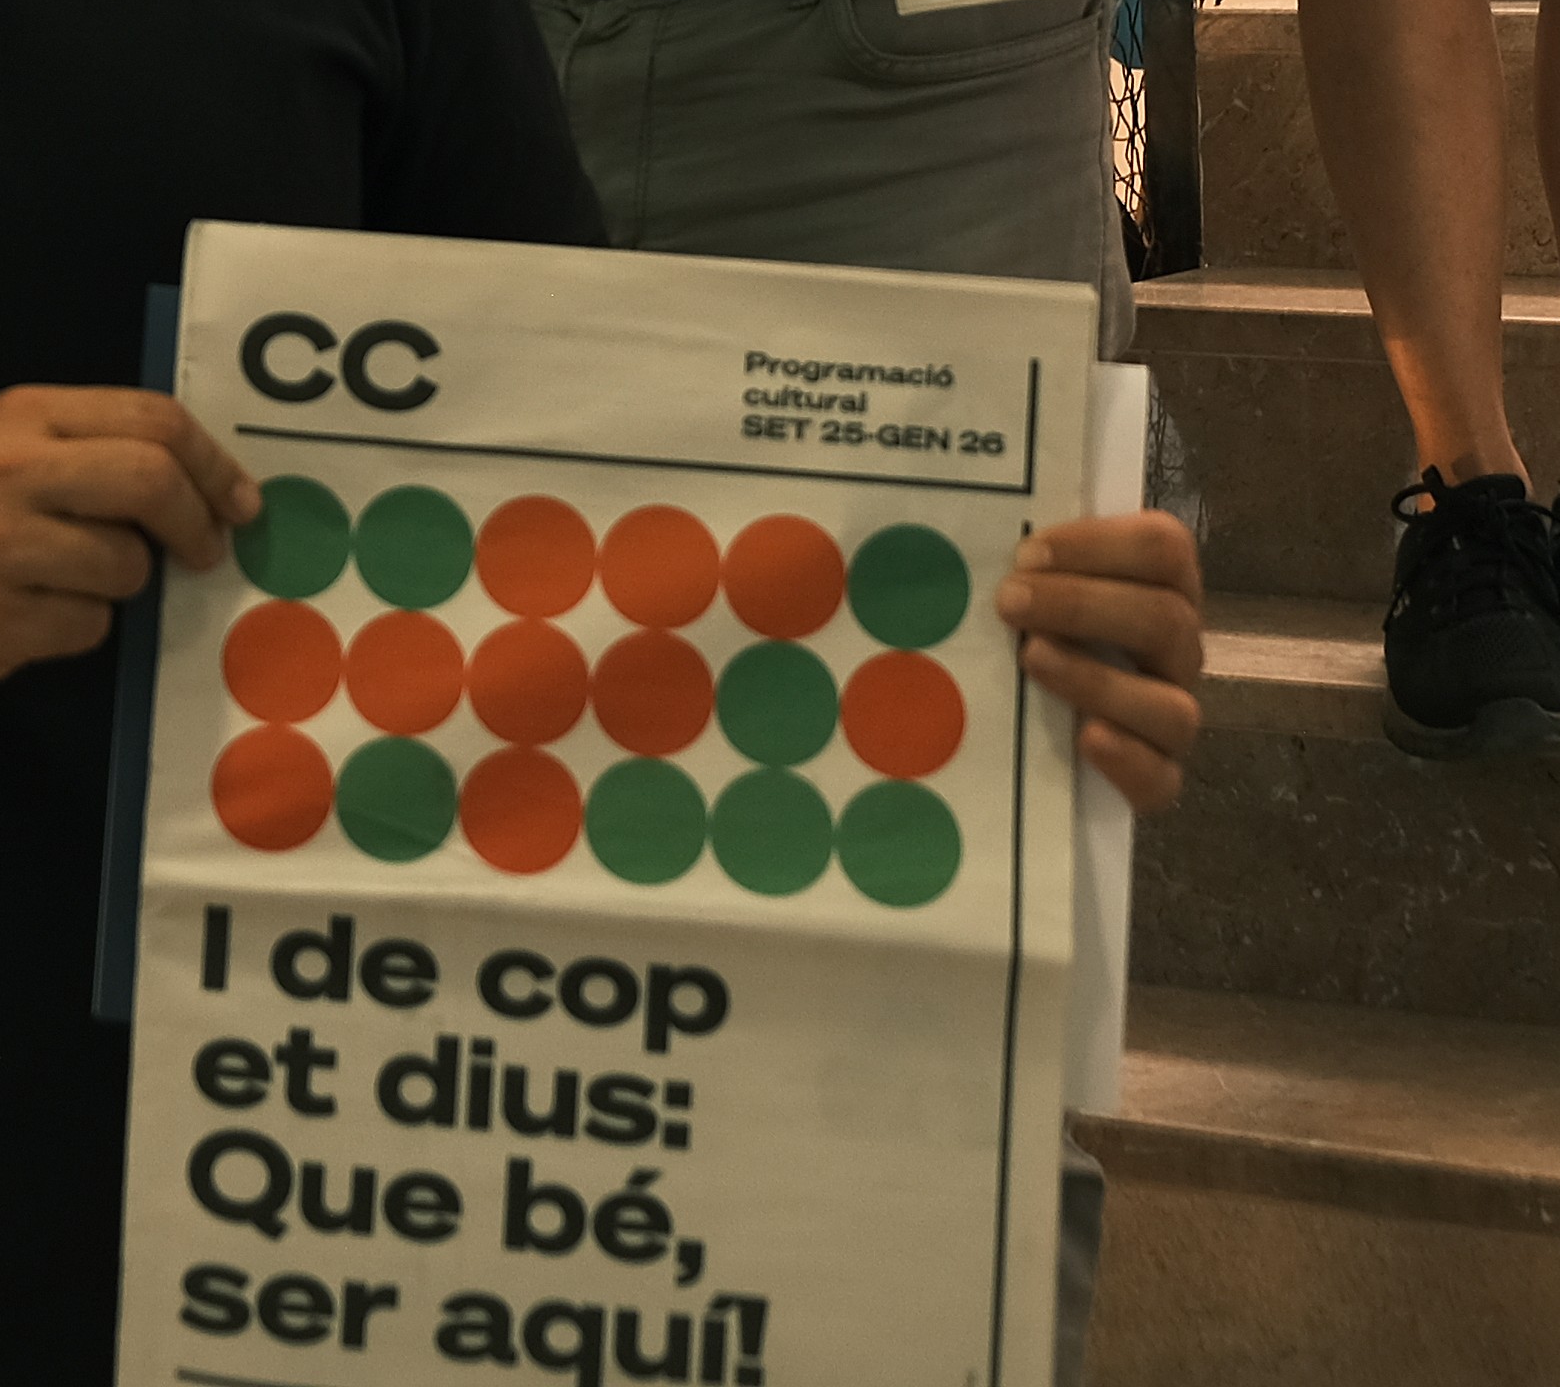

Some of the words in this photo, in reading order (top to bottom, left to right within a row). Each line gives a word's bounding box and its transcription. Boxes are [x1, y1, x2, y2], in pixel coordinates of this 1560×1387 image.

[241, 311, 440, 410] CC
[743, 385, 868, 413] cultural
[744, 350, 955, 388] Programació
[742, 414, 812, 441] SET
[821, 419, 949, 451] 25-GEN
[959, 430, 1007, 454] 26
[200, 905, 231, 992] I
[271, 916, 439, 1009] de
[477, 950, 730, 1052] cop
[193, 1029, 337, 1115] et
[377, 1037, 693, 1151] dius:
[187, 1129, 461, 1240] Que
[502, 1158, 706, 1286] bé,
[181, 1262, 399, 1351] ser
[435, 1291, 769, 1387] aquí!
